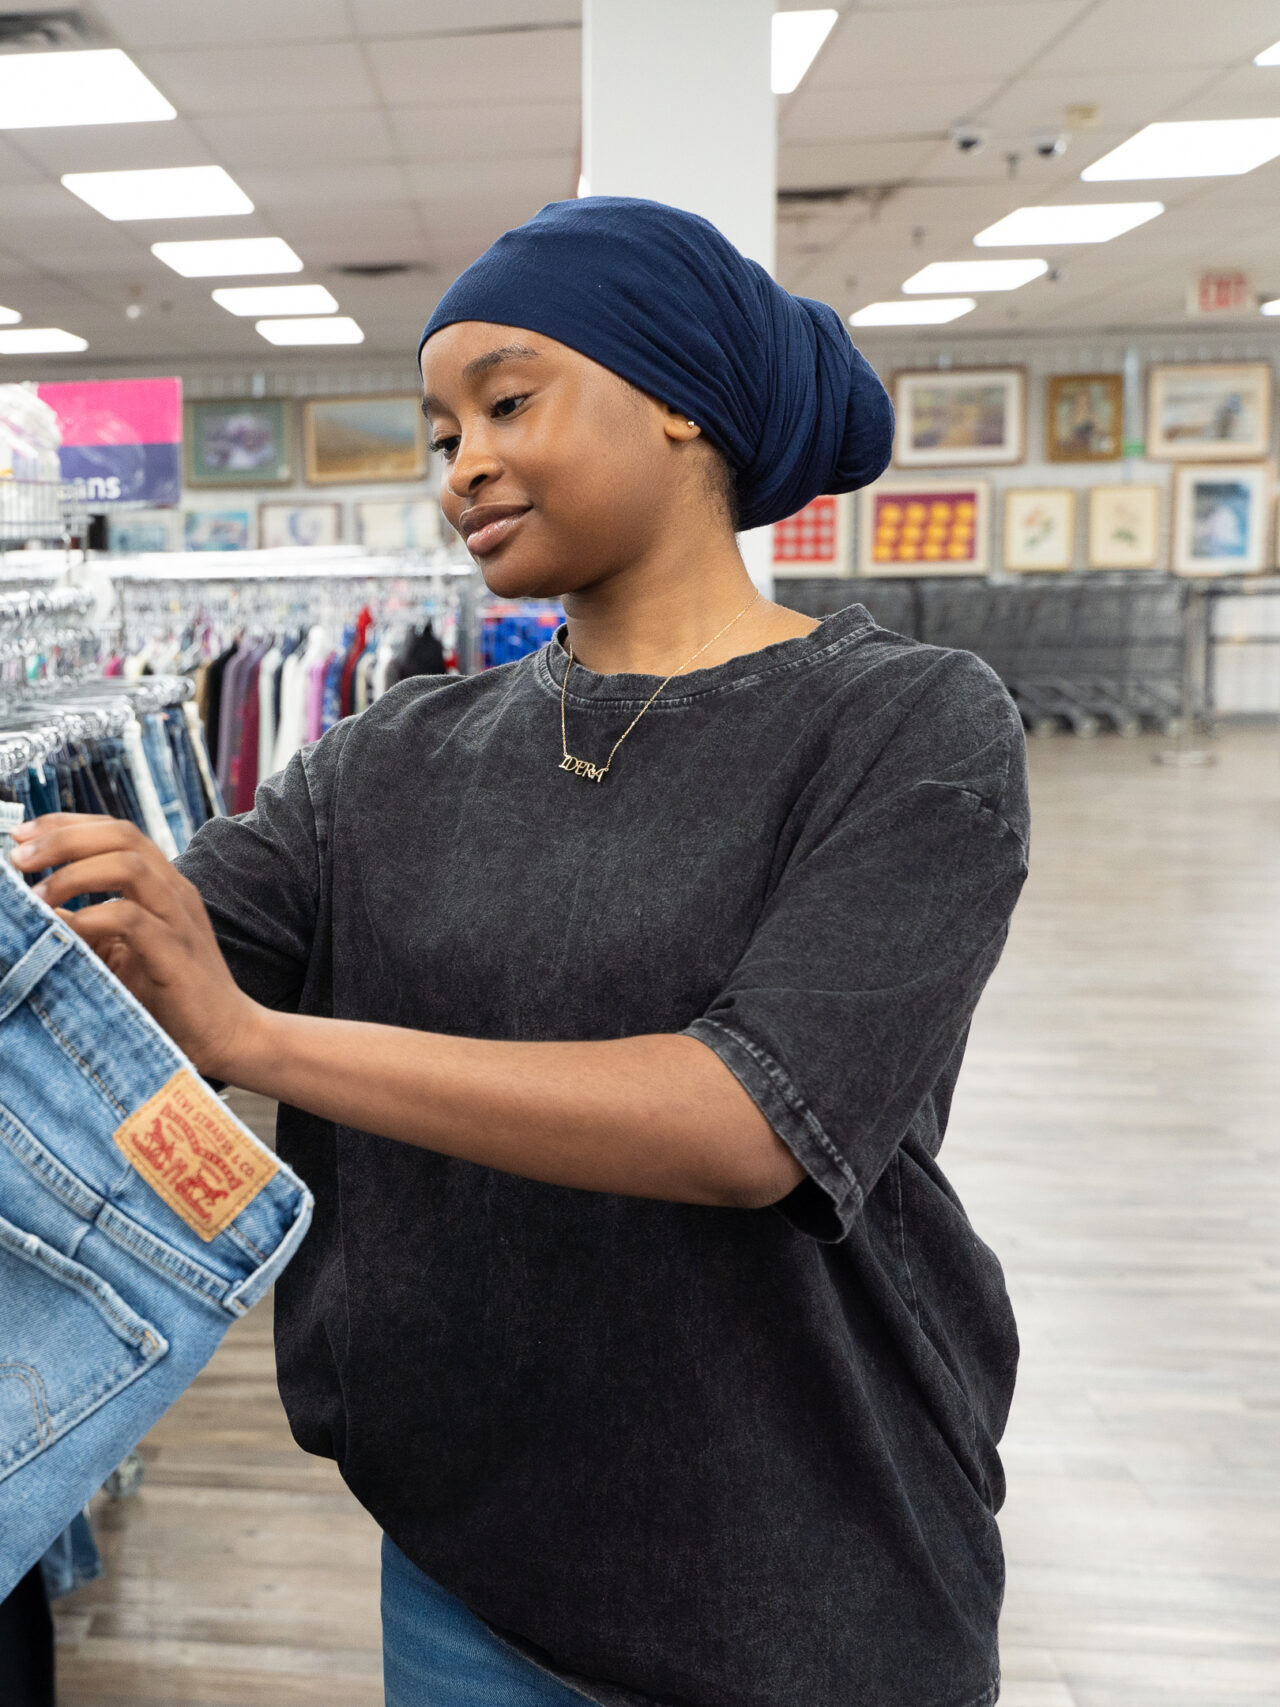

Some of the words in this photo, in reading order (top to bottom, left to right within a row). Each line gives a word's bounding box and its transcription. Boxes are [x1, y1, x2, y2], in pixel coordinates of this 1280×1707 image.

[558, 755, 606, 783] IDERA
[172, 1089, 194, 1115] LEVI
[192, 1111, 234, 1156] STRAUSS
